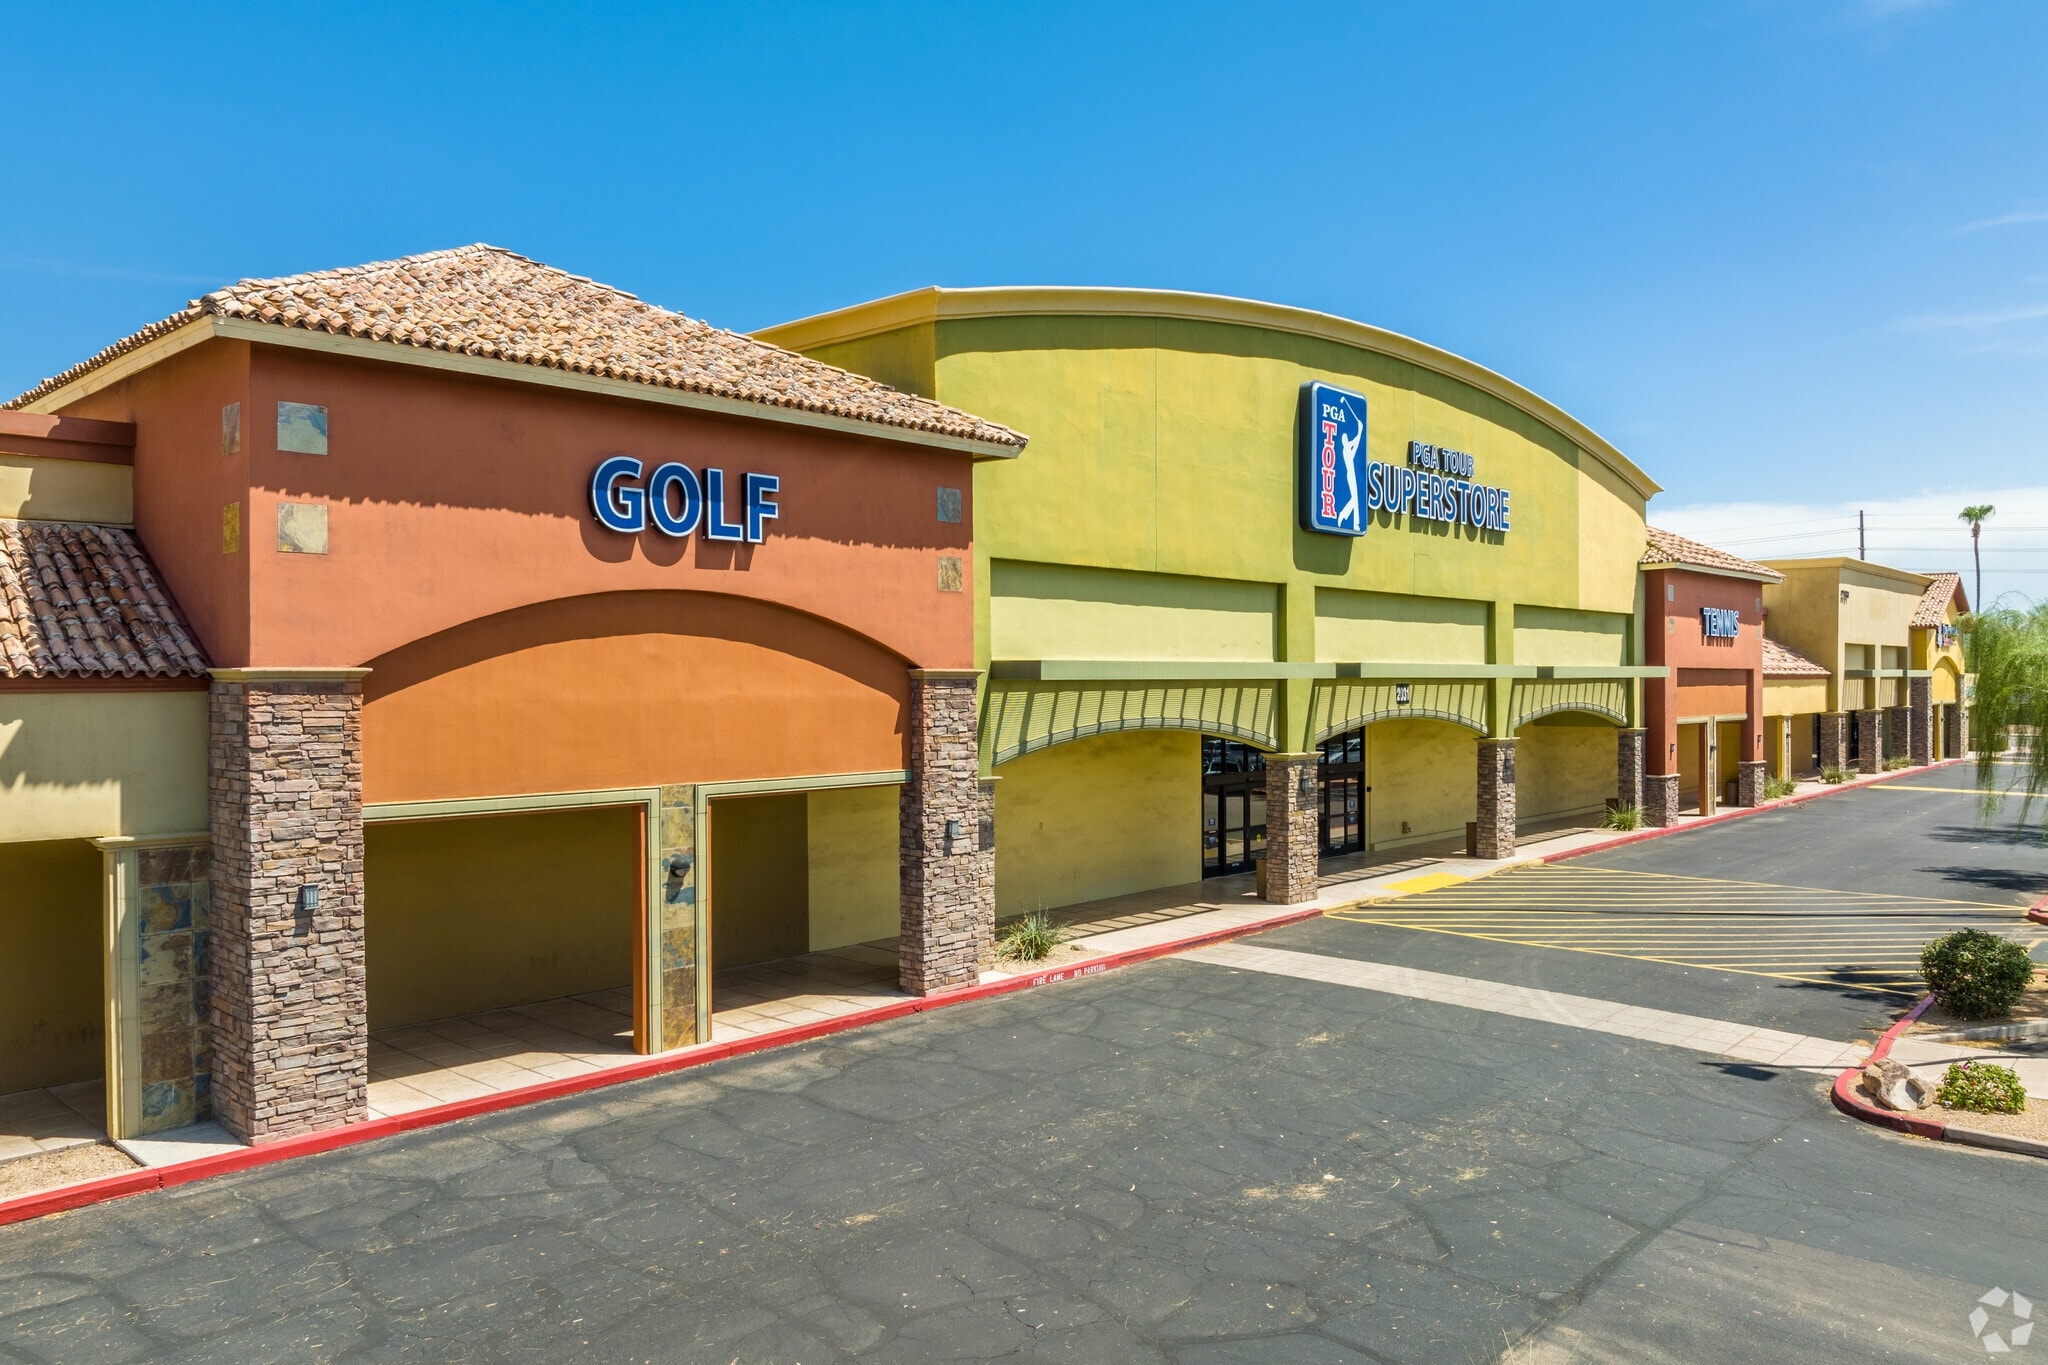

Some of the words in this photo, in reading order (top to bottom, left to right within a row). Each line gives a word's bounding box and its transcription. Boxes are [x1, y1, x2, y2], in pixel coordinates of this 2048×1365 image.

[1322, 403, 1346, 423] PGA
[1321, 419, 1338, 520] TOUR
[1410, 440, 1440, 470] PGA
[1442, 447, 1475, 478] TOUR
[589, 455, 780, 544] GOLF
[1367, 460, 1512, 533] SUPERSTORE
[1701, 606, 1740, 639] TENNIS
[1032, 975, 1047, 987] FIRE
[1049, 972, 1065, 984] LANE
[1073, 968, 1083, 978] NO
[1083, 963, 1106, 975] PARKING
